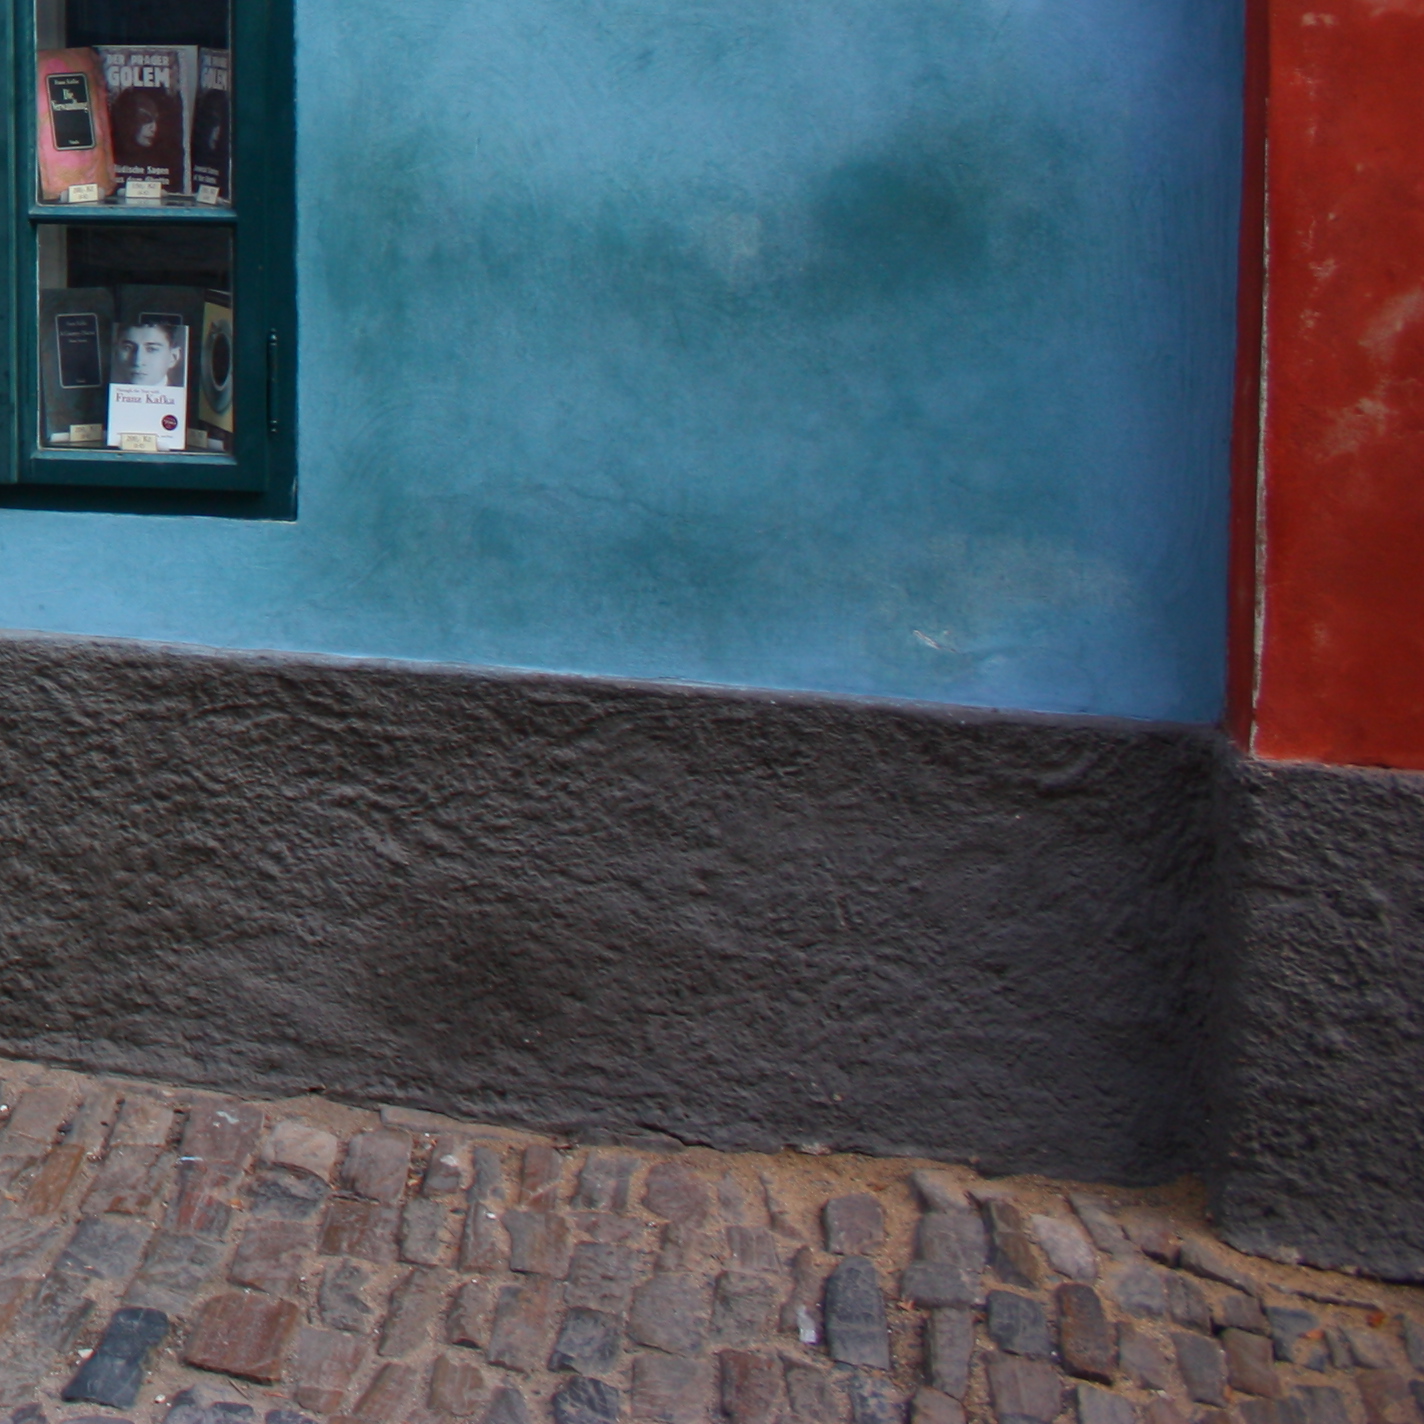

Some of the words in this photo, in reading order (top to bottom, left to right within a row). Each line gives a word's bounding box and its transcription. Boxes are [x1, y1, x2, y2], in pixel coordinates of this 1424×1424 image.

[105, 54, 125, 65] DER
[130, 53, 170, 66] PRAGER
[106, 66, 170, 88] GOLEM
[116, 392, 142, 403] Franz
[145, 393, 175, 404] Kafka
